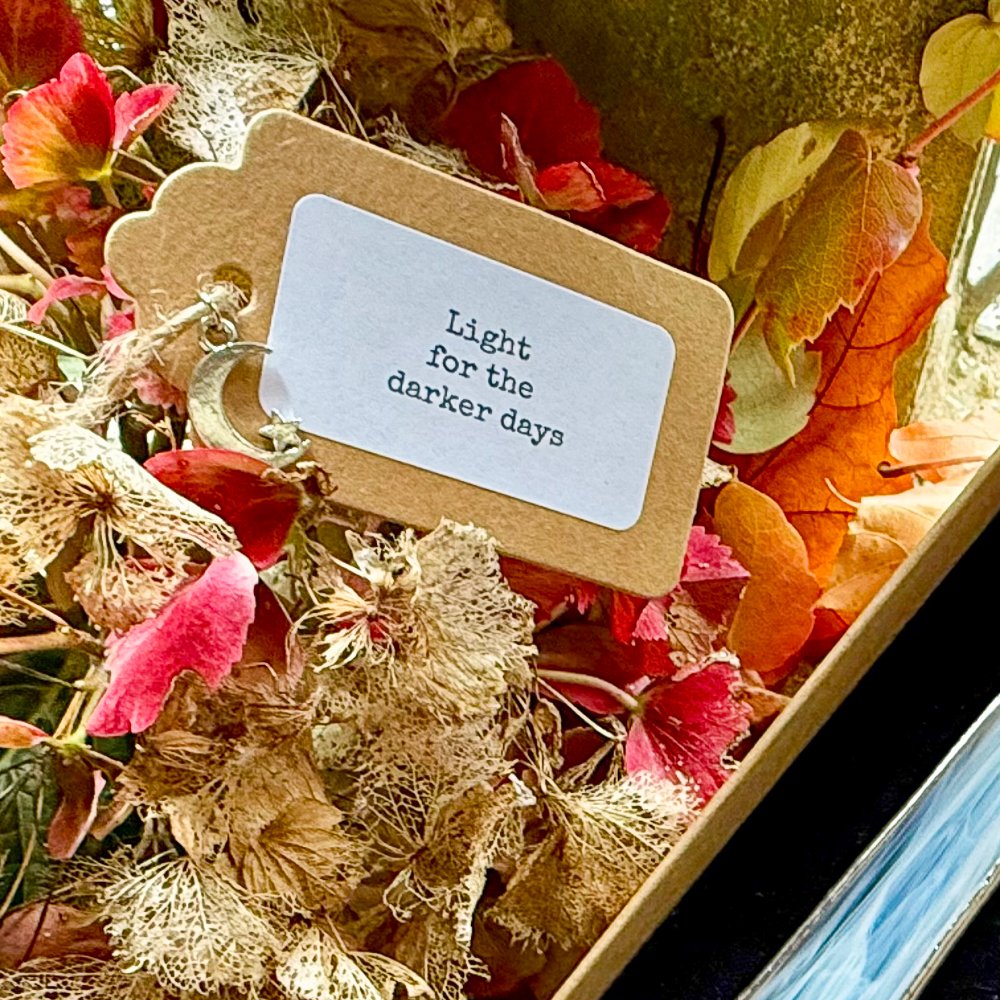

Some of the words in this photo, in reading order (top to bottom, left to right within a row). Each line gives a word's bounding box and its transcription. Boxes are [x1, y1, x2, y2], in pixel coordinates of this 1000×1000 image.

[445, 309, 532, 362] Light
[426, 345, 478, 380] for
[486, 363, 534, 399] the
[387, 371, 493, 423] darker
[500, 408, 564, 446] days
